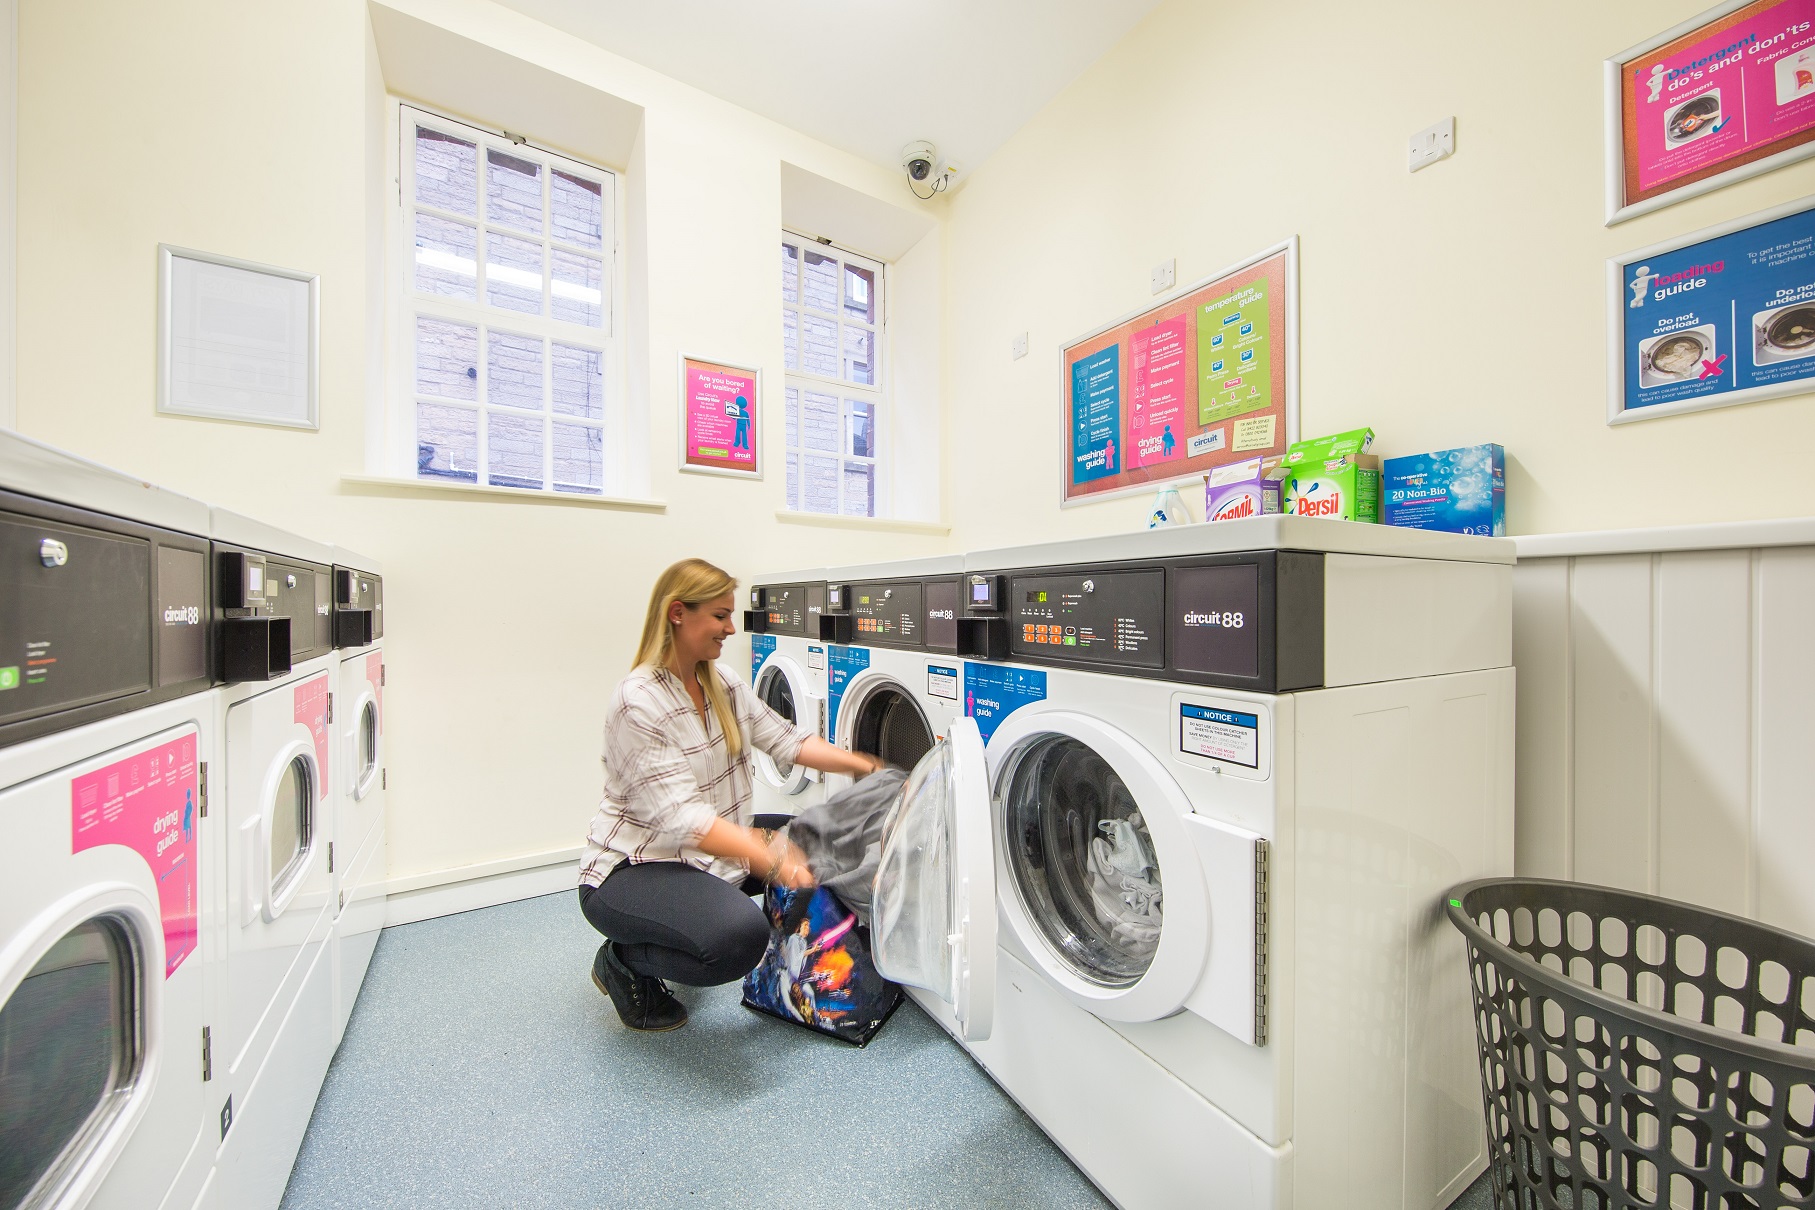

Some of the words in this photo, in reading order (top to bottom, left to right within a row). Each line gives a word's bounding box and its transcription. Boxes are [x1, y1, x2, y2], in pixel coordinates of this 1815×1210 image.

[1667, 32, 1757, 82] Detergent
[1668, 70, 1704, 92] do's
[1708, 49, 1742, 74] and
[1748, 20, 1810, 54] don'ts
[1756, 47, 1789, 65] Fabric
[1669, 80, 1714, 104] Detergent
[1760, 247, 1773, 256] get
[1793, 236, 1813, 246] best
[1769, 244, 1811, 260] important
[1768, 253, 1807, 267] machine
[1654, 260, 1725, 288] loading
[1654, 278, 1707, 301] guide
[1776, 288, 1794, 298] Do
[1205, 287, 1254, 313] temperature
[1238, 291, 1263, 308] guide
[1653, 318, 1699, 334] overload
[1658, 318, 1673, 326] Do
[1675, 312, 1694, 323] not
[1161, 330, 1173, 340] dryer
[1170, 342, 1179, 350] filter
[1099, 358, 1111, 366] washer
[1150, 365, 1161, 374] Make
[1161, 360, 1180, 371] payment
[699, 374, 710, 382] Are
[726, 379, 744, 388] bored
[1150, 381, 1162, 389] Select
[1162, 377, 1174, 386] cycle
[1680, 382, 1705, 391] damage
[712, 384, 740, 394] waiting?
[1100, 385, 1114, 395] payment
[1150, 411, 1163, 419] Unload
[1164, 407, 1179, 417] quickly
[1138, 434, 1163, 448] drying
[1194, 434, 1218, 447] circuit
[1077, 449, 1106, 463] washing
[1140, 444, 1162, 457] guide
[1086, 457, 1105, 470] guide
[1392, 490, 1404, 499] 20
[1407, 487, 1446, 499] Non-Bio
[1298, 493, 1339, 516] Persil
[164, 606, 187, 622] circuit
[187, 607, 199, 624] 88
[929, 609, 944, 619] circuit
[944, 610, 953, 620] 88
[1184, 611, 1220, 624] circuit
[1222, 612, 1244, 628] 88
[976, 698, 999, 710] washing
[977, 708, 992, 717] guide
[1204, 711, 1232, 722] NOTICE
[154, 810, 178, 834] drying
[157, 828, 178, 857] guide
